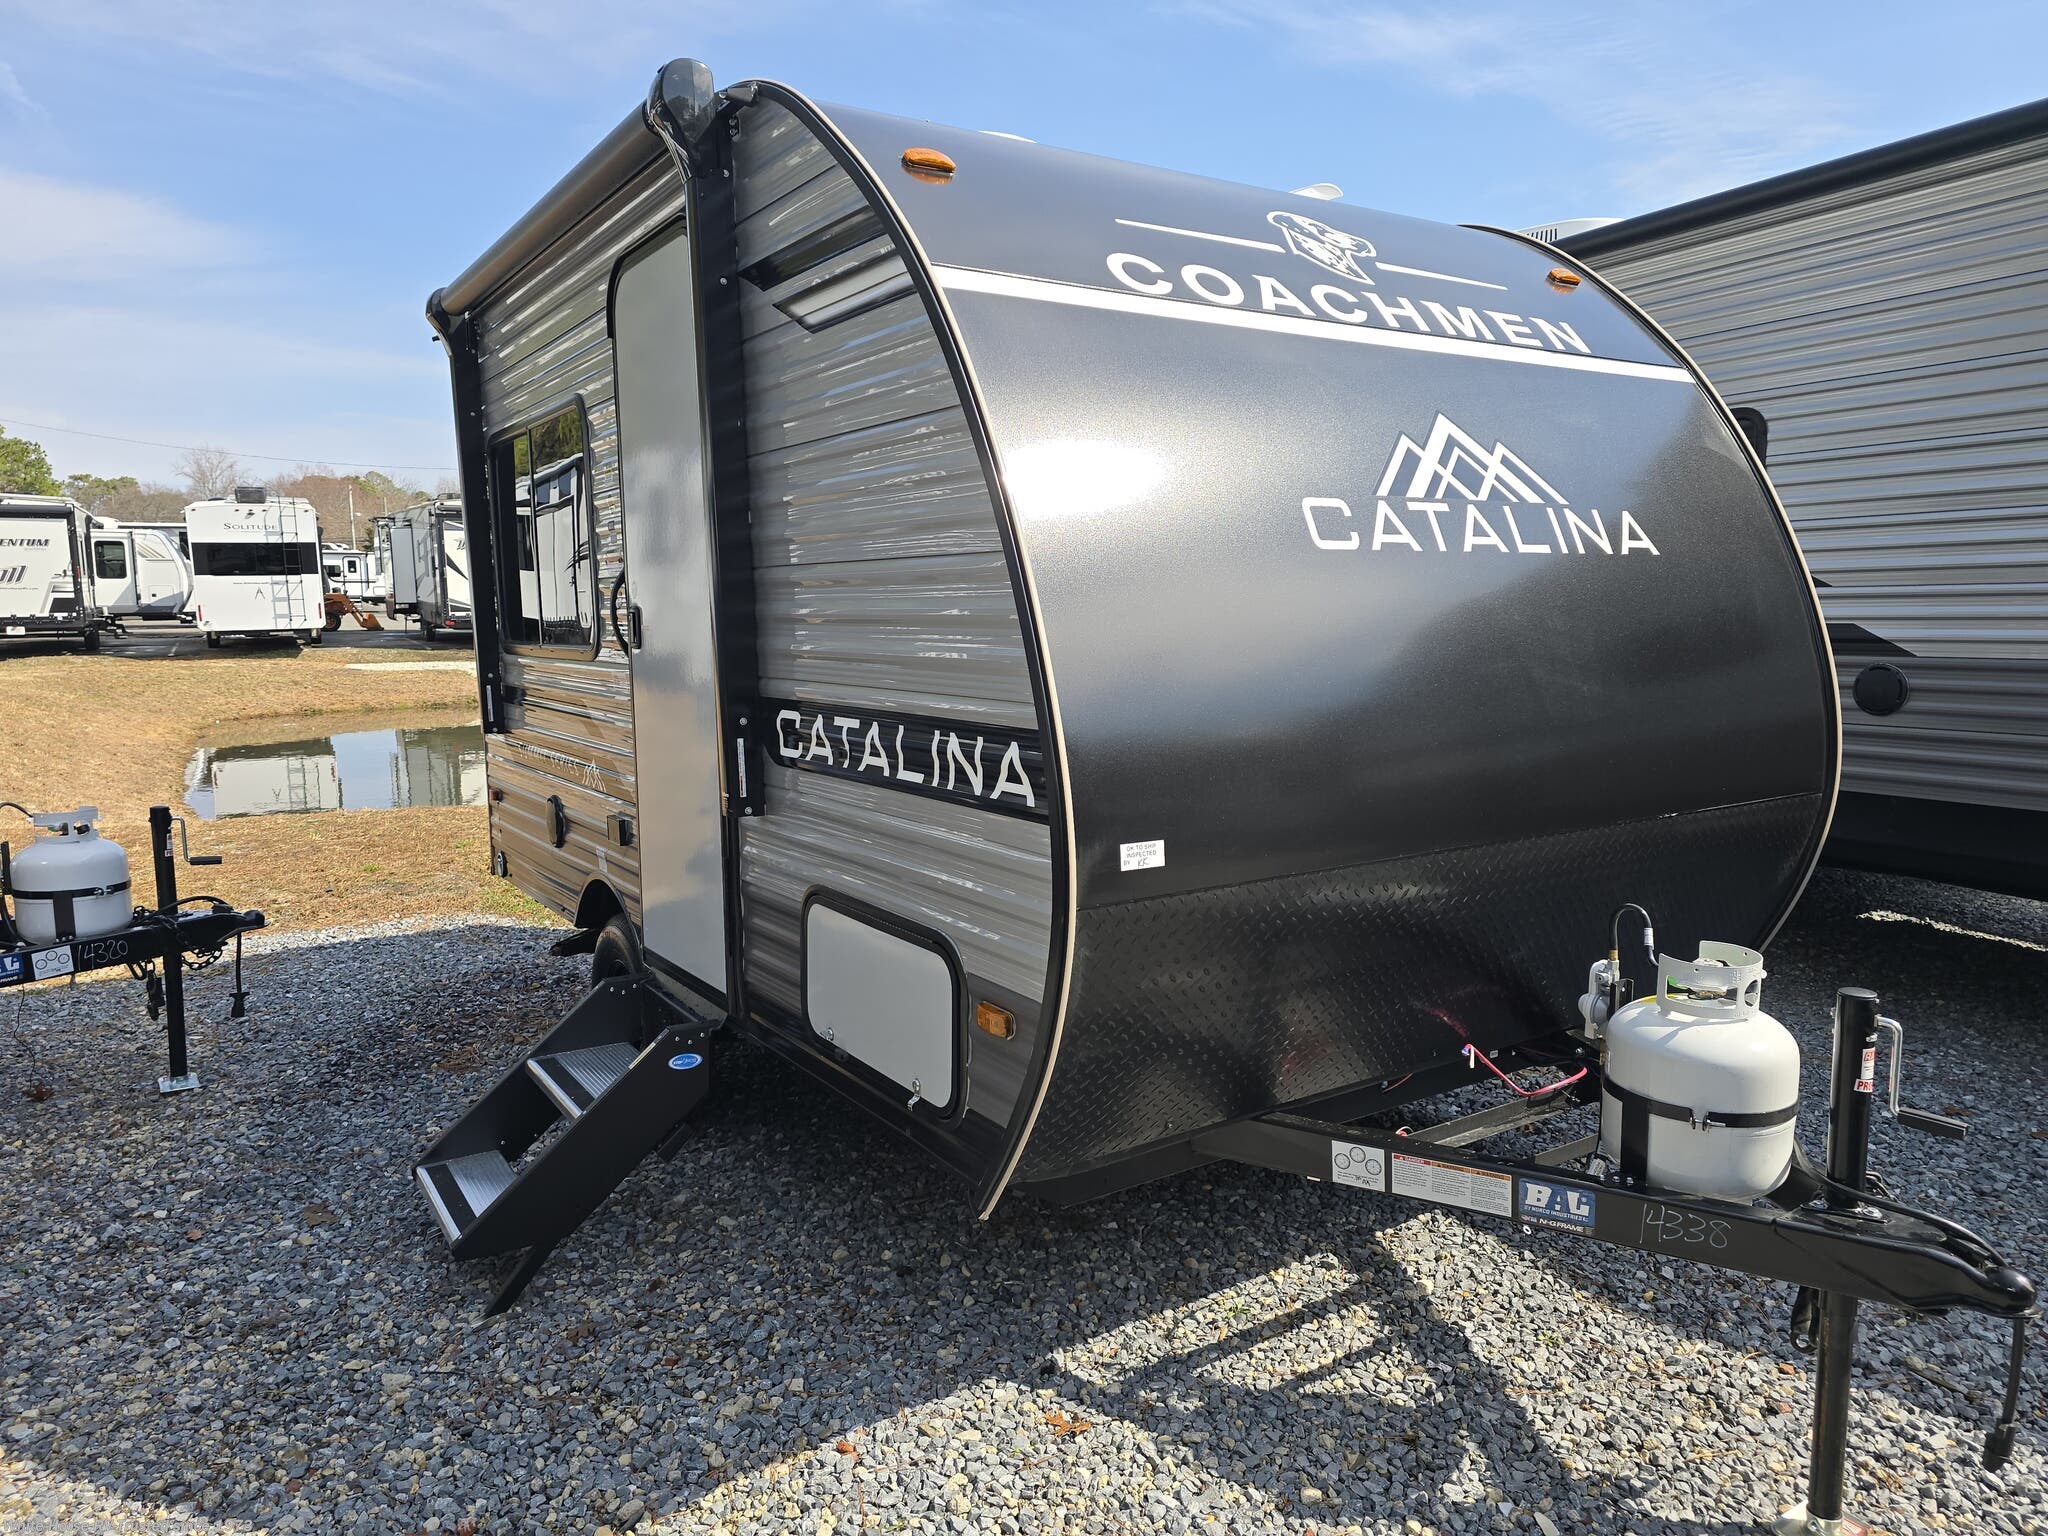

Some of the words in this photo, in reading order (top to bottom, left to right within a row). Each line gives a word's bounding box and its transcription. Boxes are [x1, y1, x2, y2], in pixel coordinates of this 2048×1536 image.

[1106, 252, 1592, 354] COACHMEN
[223, 523, 277, 531] SOLITUDE
[1301, 496, 1661, 556] CATALINA
[776, 709, 1036, 808] CATALINA
[78, 939, 129, 972] 14320
[1639, 1203, 1732, 1248] 14338
